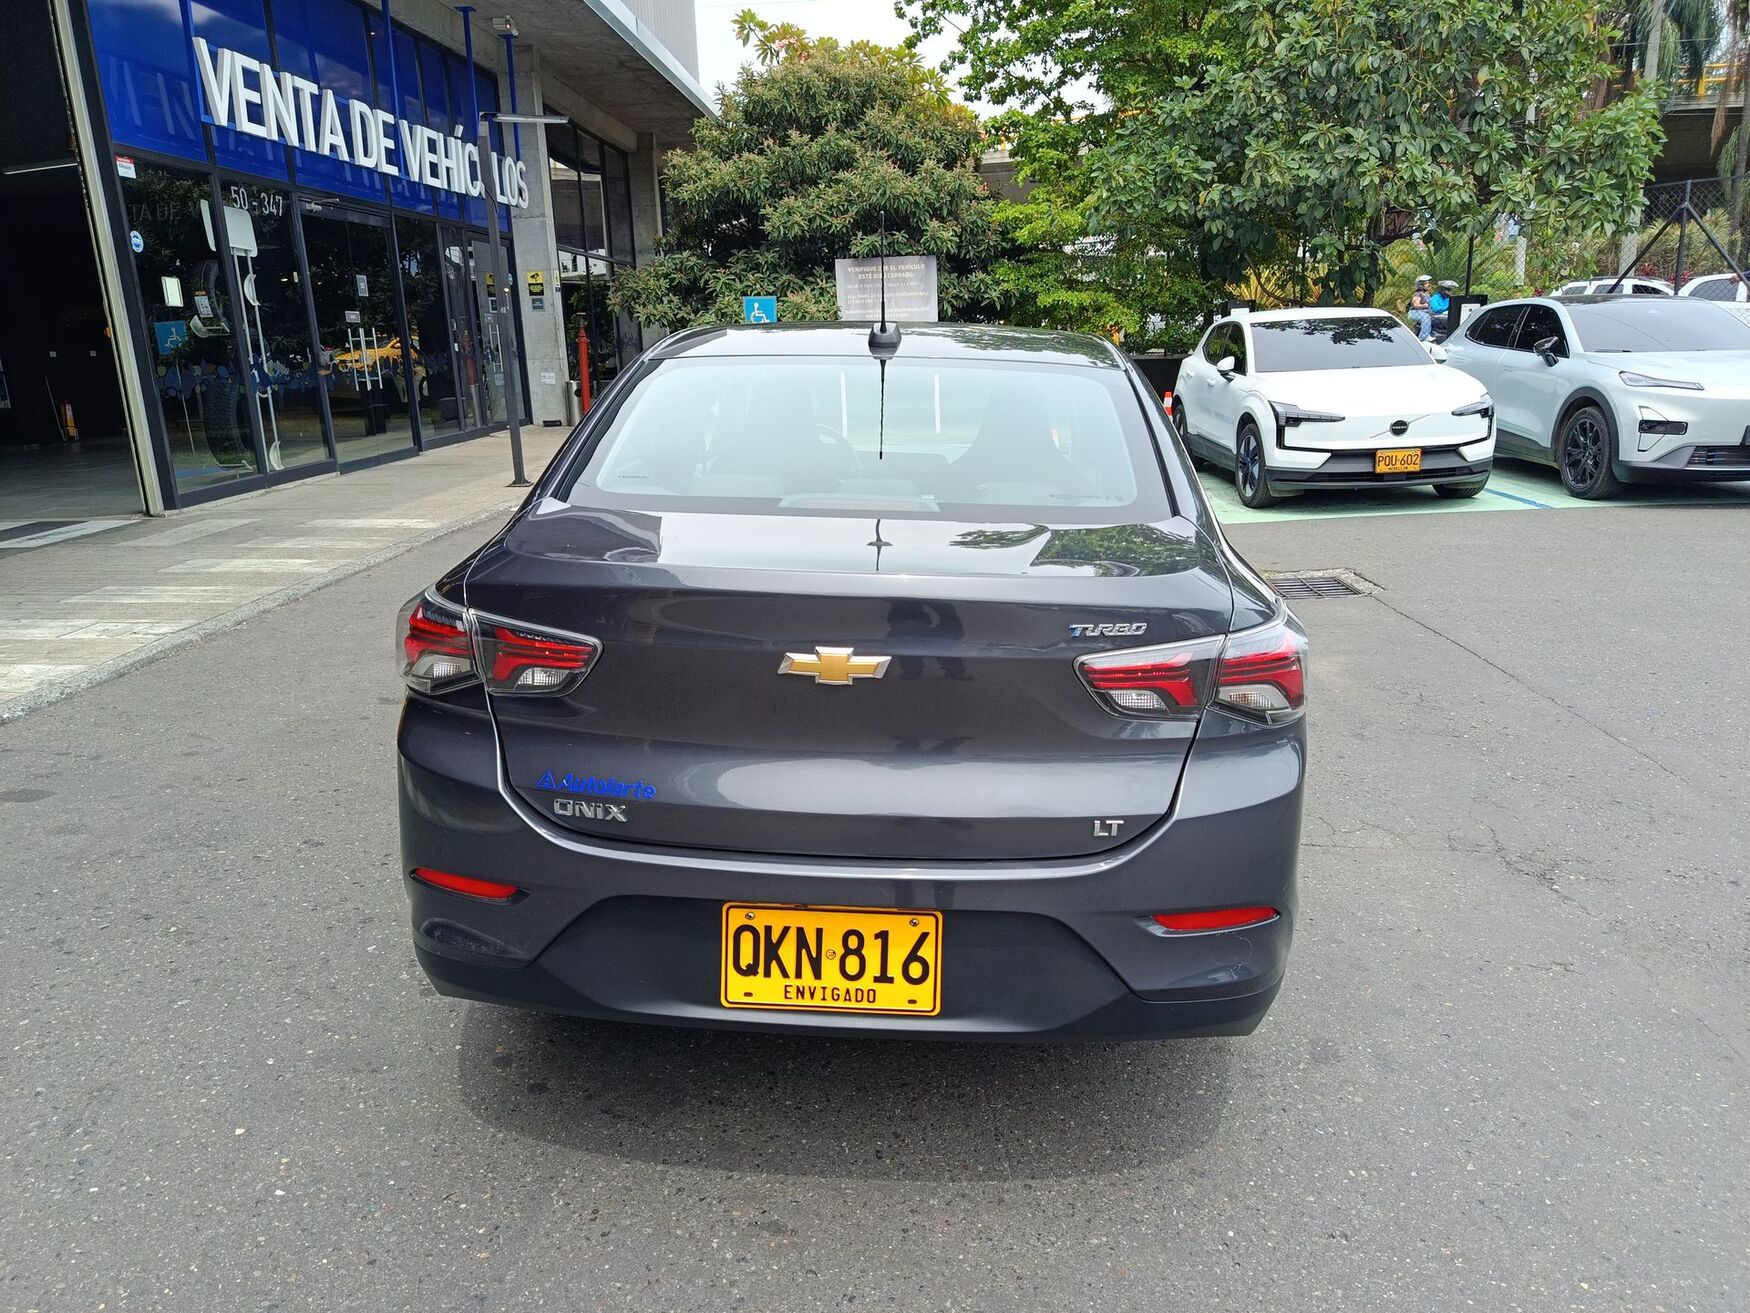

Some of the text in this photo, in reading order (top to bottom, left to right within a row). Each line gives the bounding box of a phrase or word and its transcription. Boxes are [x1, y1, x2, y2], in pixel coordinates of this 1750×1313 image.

[192, 37, 349, 162] VENTA
[349, 99, 399, 177] DE
[230, 185, 248, 210] 50
[260, 192, 283, 217] 347
[1399, 453, 1420, 466] 602
[1068, 622, 1147, 638] TURBO
[1093, 820, 1124, 836] LT
[733, 924, 930, 985] QKN 816
[784, 984, 876, 1004] ENVIGADO
